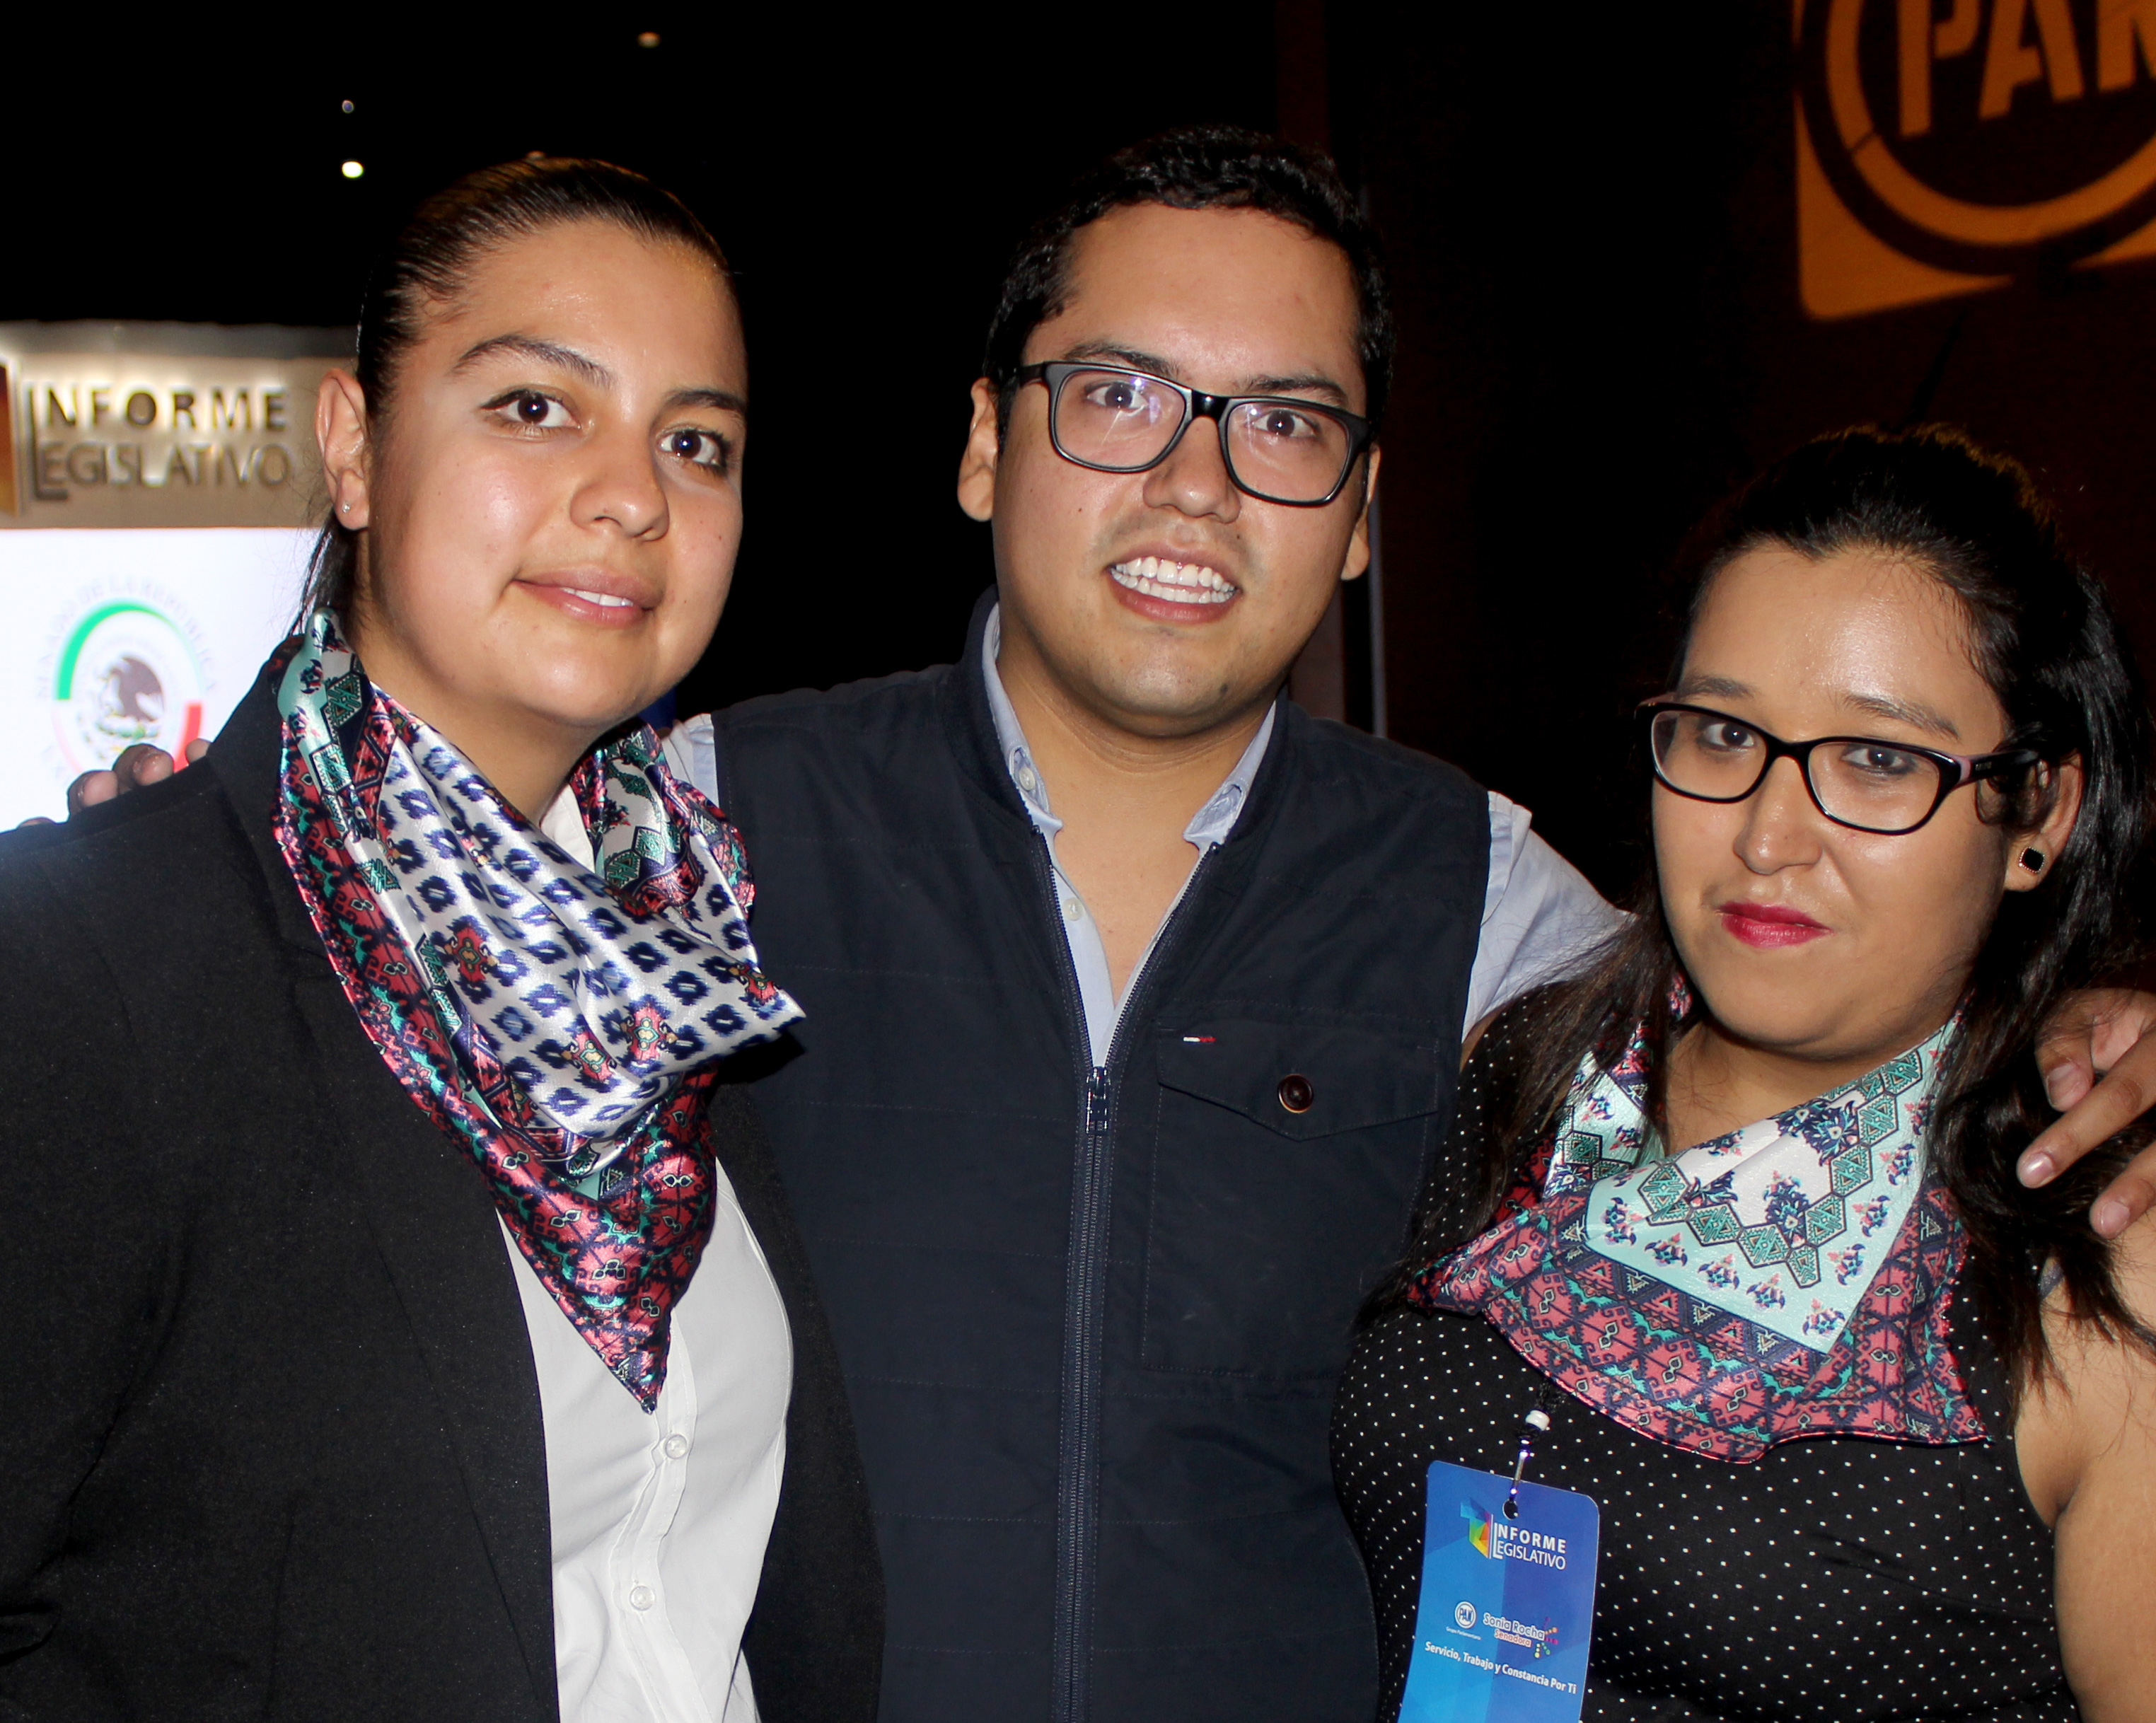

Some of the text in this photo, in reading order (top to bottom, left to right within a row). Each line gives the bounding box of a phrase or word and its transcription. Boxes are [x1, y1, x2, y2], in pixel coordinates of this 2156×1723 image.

[1493, 1522, 1567, 1554] INFORME
[1493, 1540, 1567, 1570] LEGISLATIVO
[1483, 1612, 1546, 1641] Sonia Rocha
[1494, 1628, 1533, 1648] Senadora
[1425, 1641, 1577, 1695] Servicio, Trabajo y Constancia Por Ti
